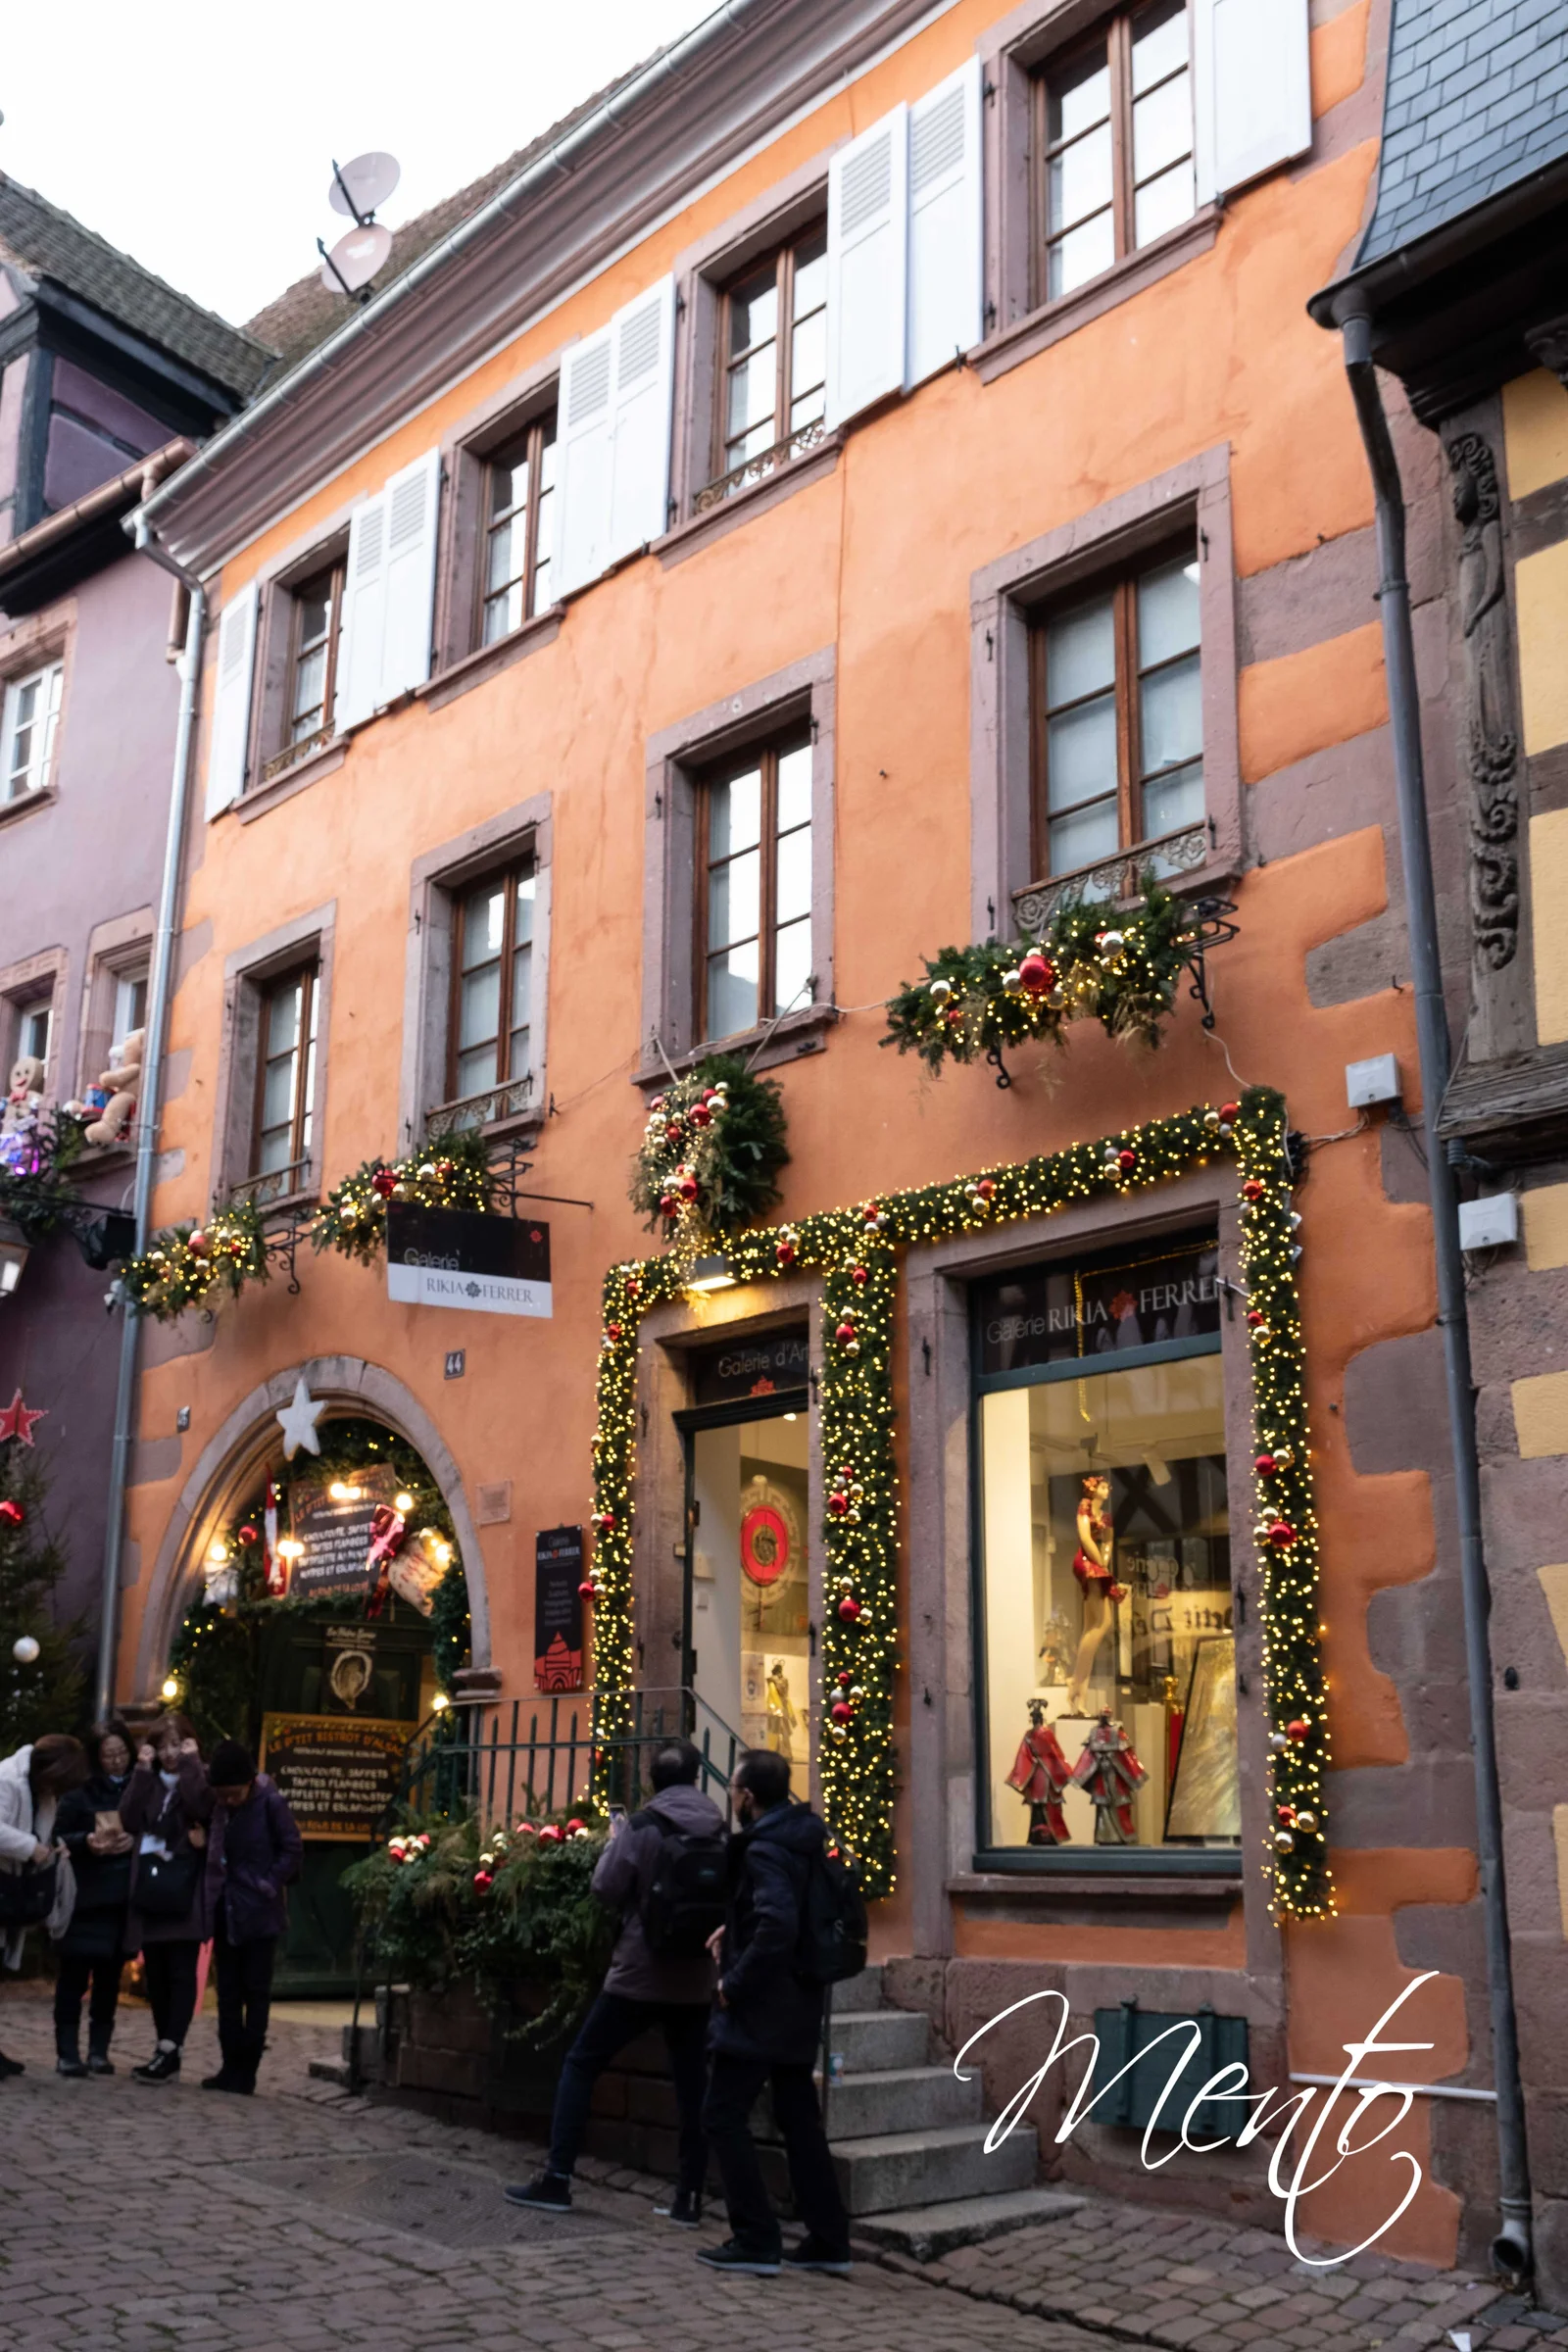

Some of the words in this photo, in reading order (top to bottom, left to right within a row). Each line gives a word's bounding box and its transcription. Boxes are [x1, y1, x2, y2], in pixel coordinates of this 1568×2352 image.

[404, 1248, 460, 1271] Galerie
[426, 1278, 466, 1296] RIKIA
[482, 1284, 533, 1303] FERRER
[987, 1316, 1046, 1345] Galerie
[1048, 1299, 1108, 1333] RIKIA
[447, 1353, 462, 1374] 44
[718, 1352, 770, 1378] Galerie
[775, 1342, 809, 1366] d'Ar
